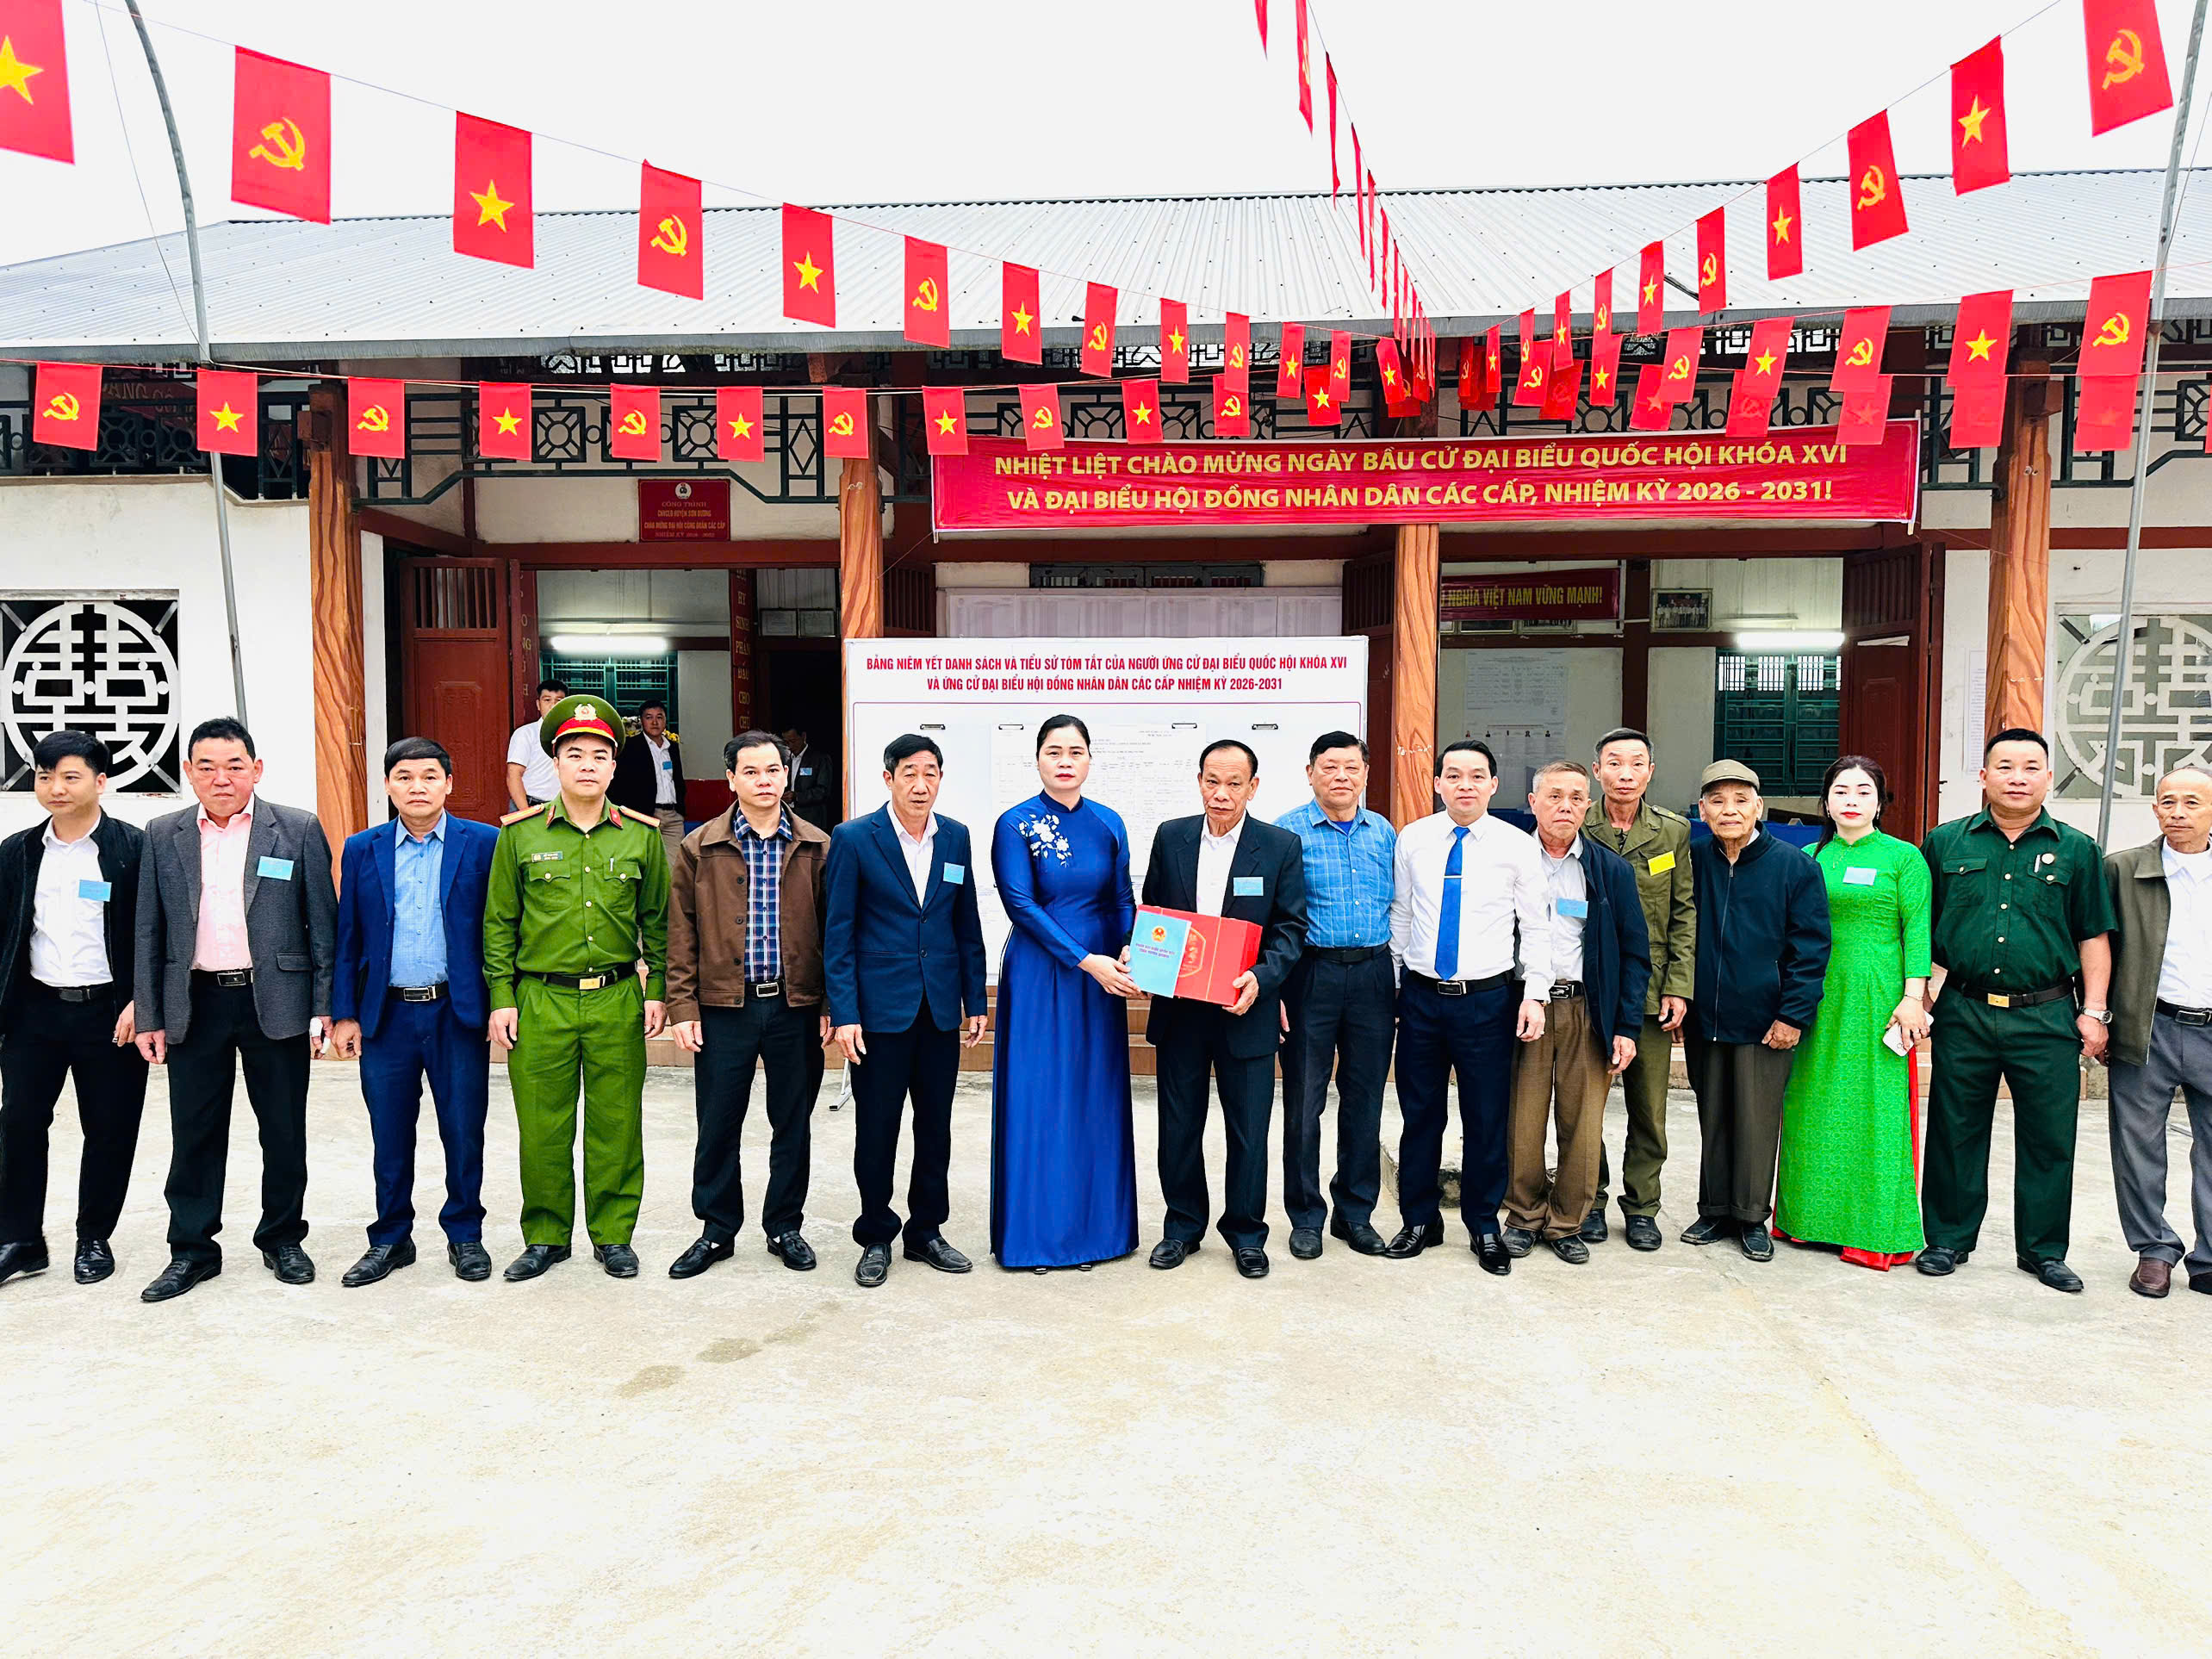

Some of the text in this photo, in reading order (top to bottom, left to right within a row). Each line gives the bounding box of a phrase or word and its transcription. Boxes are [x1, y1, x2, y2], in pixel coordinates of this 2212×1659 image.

[995, 441, 1847, 480] NHIỆT LIỆT CHÀO MỪNG NGÀY BẦU CỬ ĐẠI BIỂU QUỐC HỘI KHÓA XVI
[1007, 487, 1040, 509] VÀ
[1044, 491, 1088, 514] ĐẠI
[1094, 483, 1148, 509] BIỂU
[1154, 486, 1198, 514] HỘI
[1203, 483, 1279, 508] ĐỒNG
[1285, 484, 1358, 507] NHÂN
[1364, 482, 1420, 506] DÂN
[1426, 482, 1477, 505] CÁC
[1482, 478, 1538, 506] CẤP,
[1544, 478, 1630, 507] NHIỆM
[1636, 477, 1671, 501] KỲ
[1677, 482, 1741, 500] 2026
[1761, 481, 1832, 500] 2031!
[1448, 586, 1480, 606] NGHĨA
[1482, 584, 1505, 610] VIỆT
[1507, 587, 1532, 606] NAM
[1535, 583, 1564, 606] VỮNG
[1567, 586, 1603, 608] MẠNH!
[867, 652, 1347, 673] BẢNG NIÊM YẾT DANH SÁCH VÀ TIỂU SỬ TÓM TẮT CỦA NGƯỜI ỨNG CỬ ĐẠI BIỂU QUỐC HỘI KHÓA XVI
[927, 673, 1283, 693] VÀ ỨNG CỬ ĐẠI BIỂU HỘI ĐỒNG NHÂN DÂN CÁC CẤP NHIỆM KỲ 2026-2031
